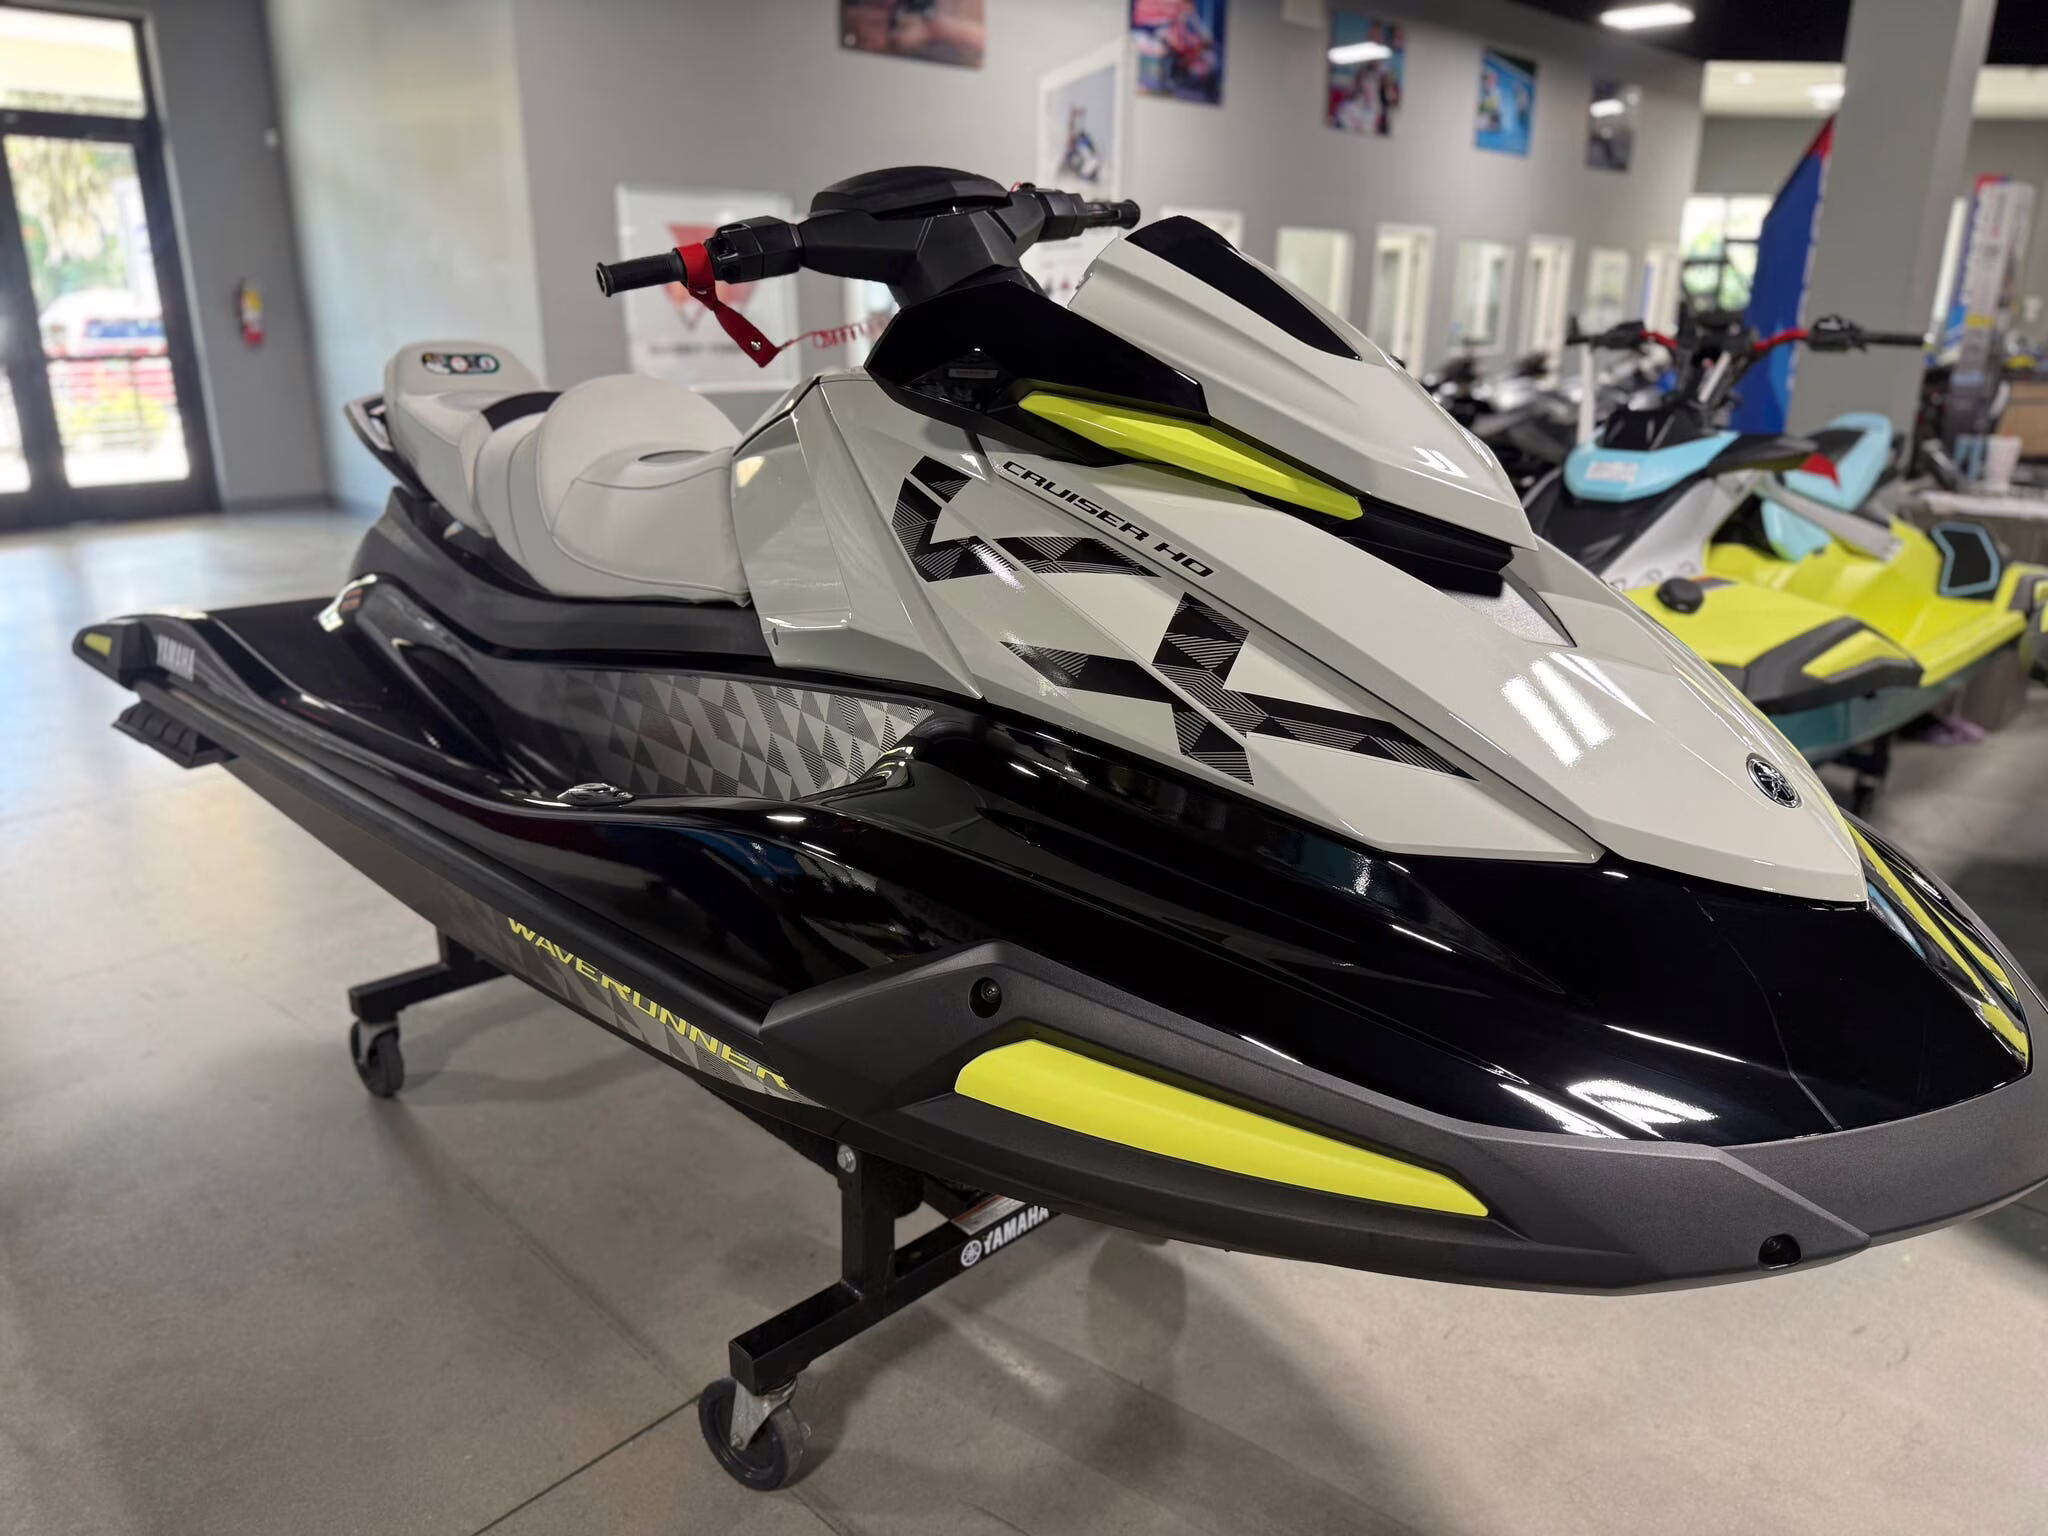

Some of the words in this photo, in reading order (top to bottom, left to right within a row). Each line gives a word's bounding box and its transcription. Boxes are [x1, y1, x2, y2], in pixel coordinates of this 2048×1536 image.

[1002, 460, 1150, 542] CRUISER
[1154, 542, 1214, 578] HO
[507, 917, 790, 1091] WAVERUNNER
[983, 1205, 1050, 1255] YAMAHA
